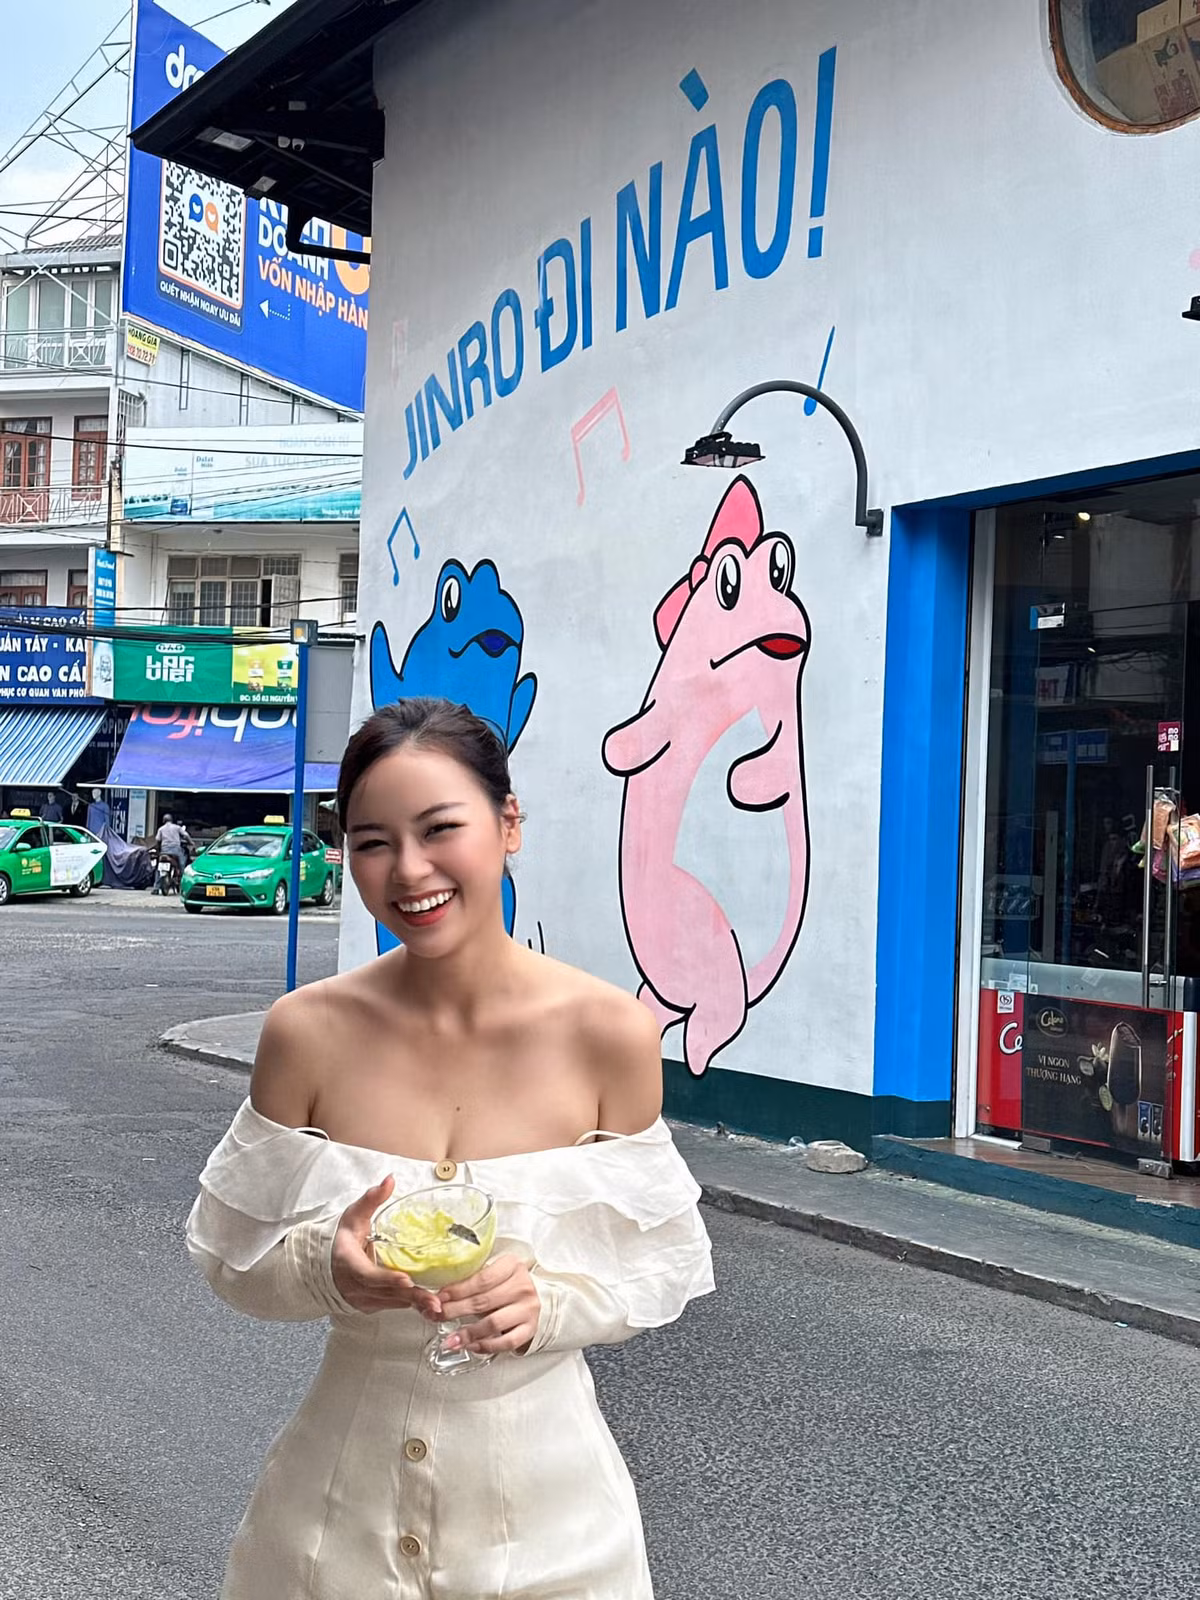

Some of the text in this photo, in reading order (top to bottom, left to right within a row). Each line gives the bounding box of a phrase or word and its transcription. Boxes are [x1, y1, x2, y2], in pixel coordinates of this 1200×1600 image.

[402, 45, 837, 480] JINRO ĐI NÀO!
[160, 281, 180, 298] QUÉT
[180, 290, 200, 307] NHẬN
[200, 299, 219, 316] NGAY
[258, 255, 292, 294] VỐN
[295, 275, 336, 317] NHẬP
[17, 665, 52, 682] CAO
[28, 688, 50, 698] QUAN
[1047, 1056, 1070, 1068] NGON
